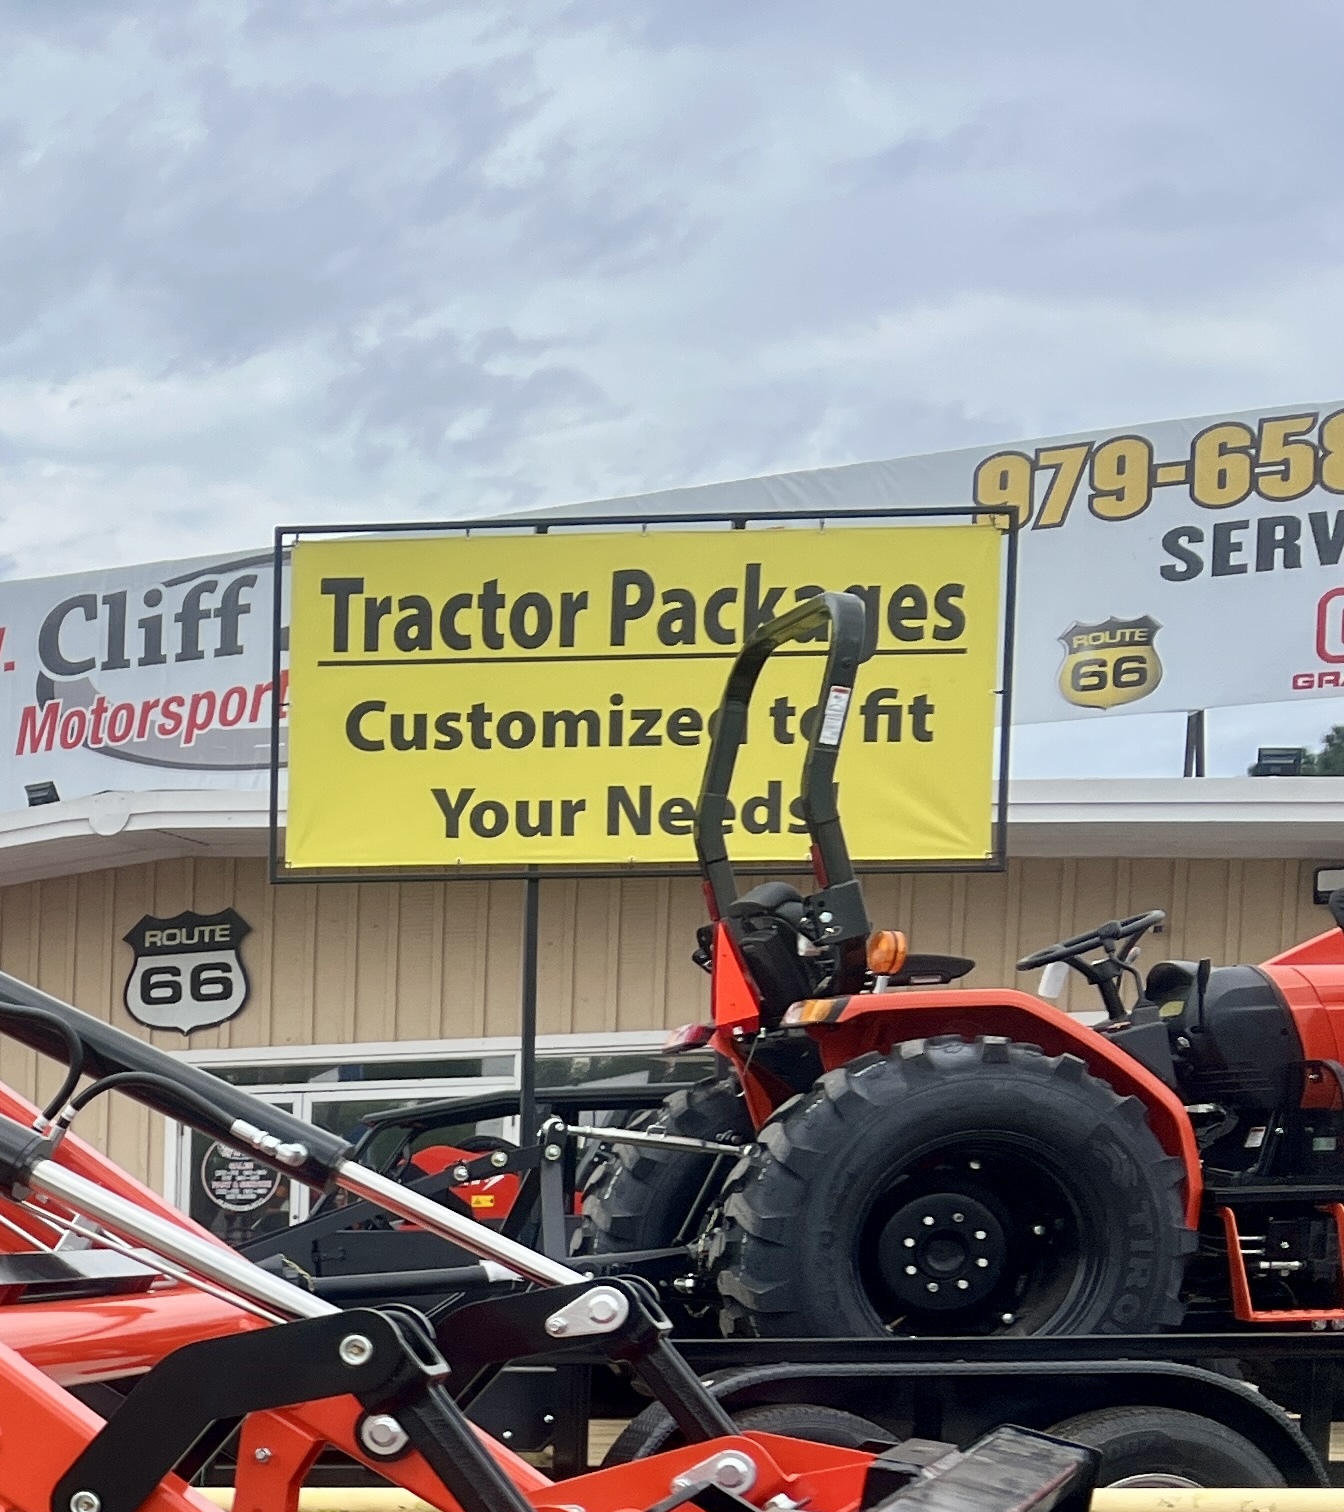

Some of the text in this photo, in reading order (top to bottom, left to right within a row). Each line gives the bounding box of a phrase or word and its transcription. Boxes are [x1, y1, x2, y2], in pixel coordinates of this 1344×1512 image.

[37, 573, 259, 678] Cliff
[320, 576, 590, 654] Tractor
[1071, 627, 1150, 649] ROUTE
[1070, 654, 1148, 693] 66
[1291, 671, 1344, 690] GR
[858, 687, 935, 744] fit
[429, 787, 587, 840] Your
[144, 924, 231, 947] ROUTE
[140, 961, 233, 1006] 66
